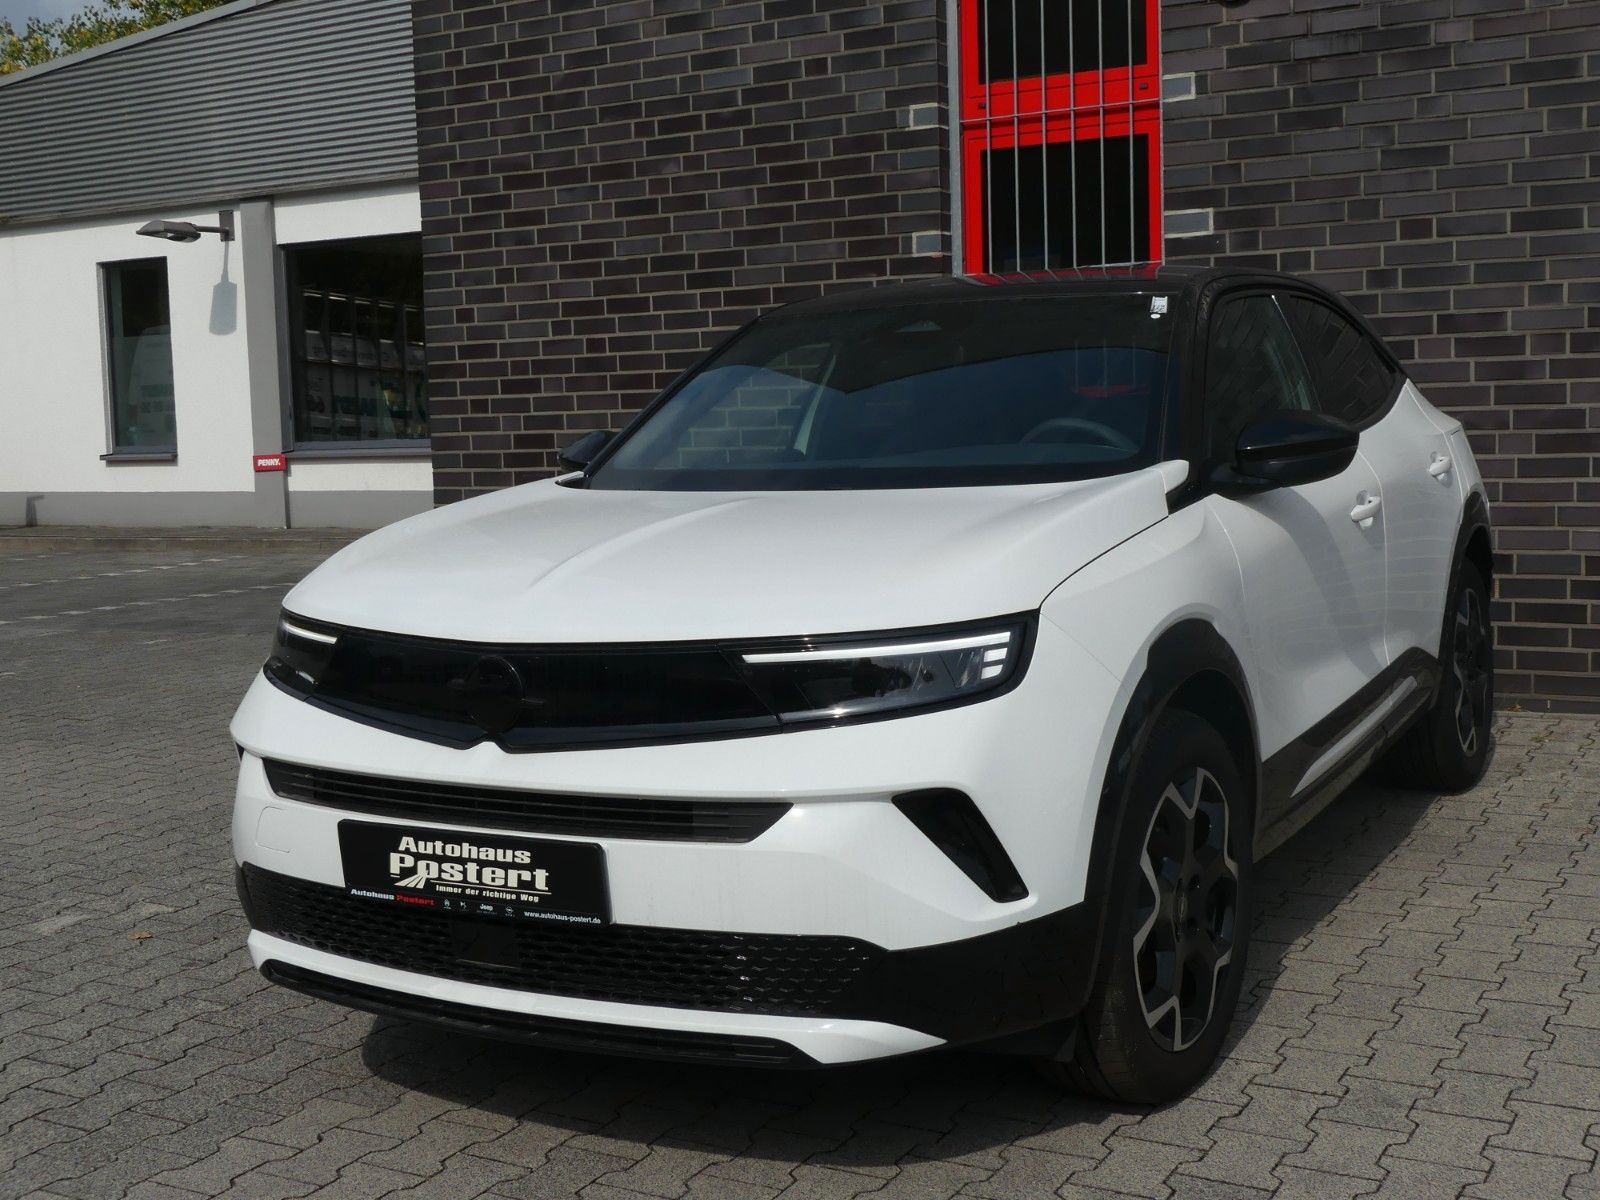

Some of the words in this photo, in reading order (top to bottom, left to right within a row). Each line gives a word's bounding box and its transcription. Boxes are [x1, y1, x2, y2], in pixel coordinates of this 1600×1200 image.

[398, 836, 531, 864] Autohaus
[389, 852, 549, 891] Postert
[350, 888, 395, 900] Autohaus
[436, 885, 464, 895] Immer
[465, 887, 479, 896] der
[483, 889, 517, 901] richtige
[520, 893, 539, 903] Weg
[523, 911, 601, 924] www.autohaus-postert.de
